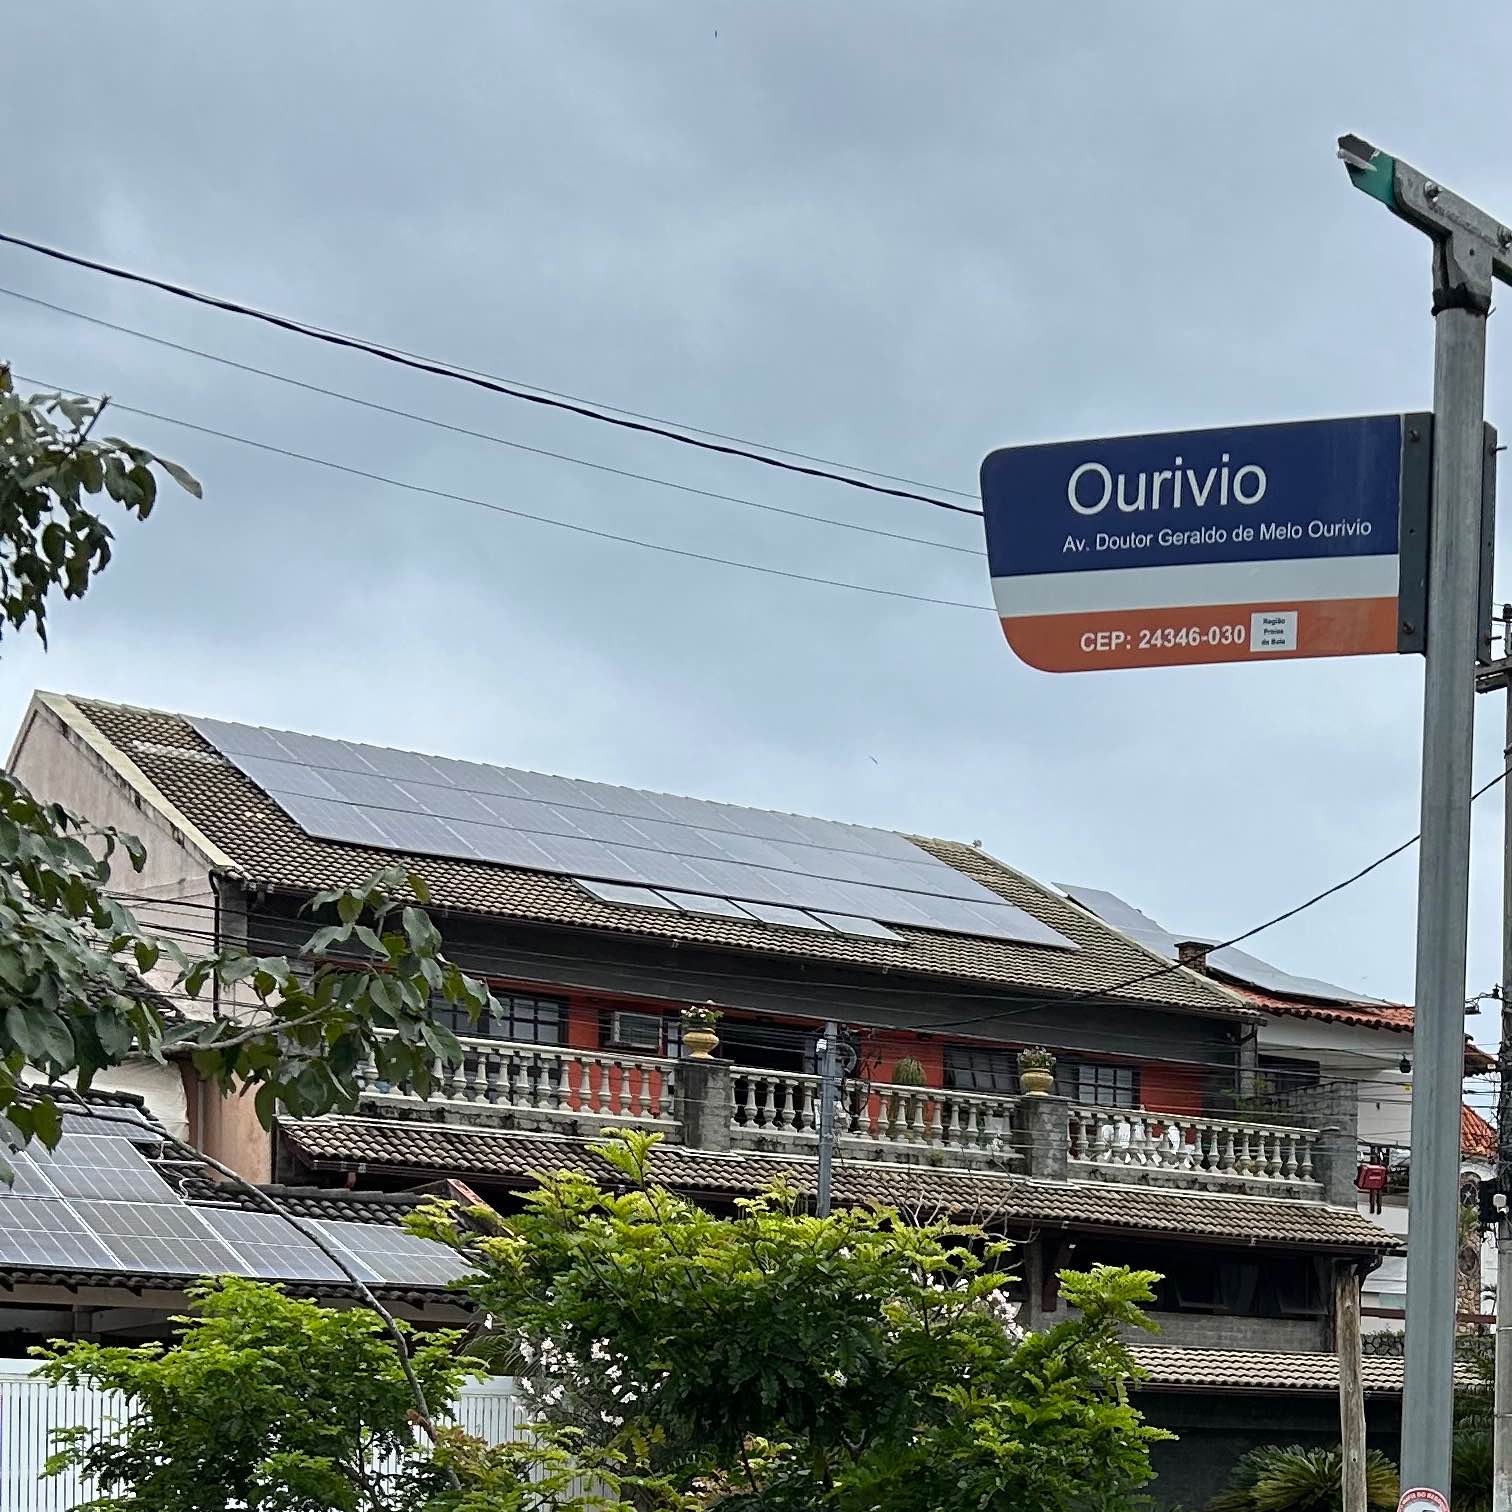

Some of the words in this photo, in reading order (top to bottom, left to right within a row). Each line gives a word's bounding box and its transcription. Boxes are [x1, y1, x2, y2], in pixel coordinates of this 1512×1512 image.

[1067, 453, 1267, 516] Ourivio
[1062, 535, 1090, 553] Av.
[1095, 531, 1154, 551] Doutor
[1158, 525, 1227, 546] Geraldo
[1231, 524, 1254, 542] de
[1259, 522, 1303, 541] Melo
[1308, 518, 1372, 538] Ourivio
[1080, 631, 1131, 652] CEP:
[1138, 624, 1246, 649] 24346-030
